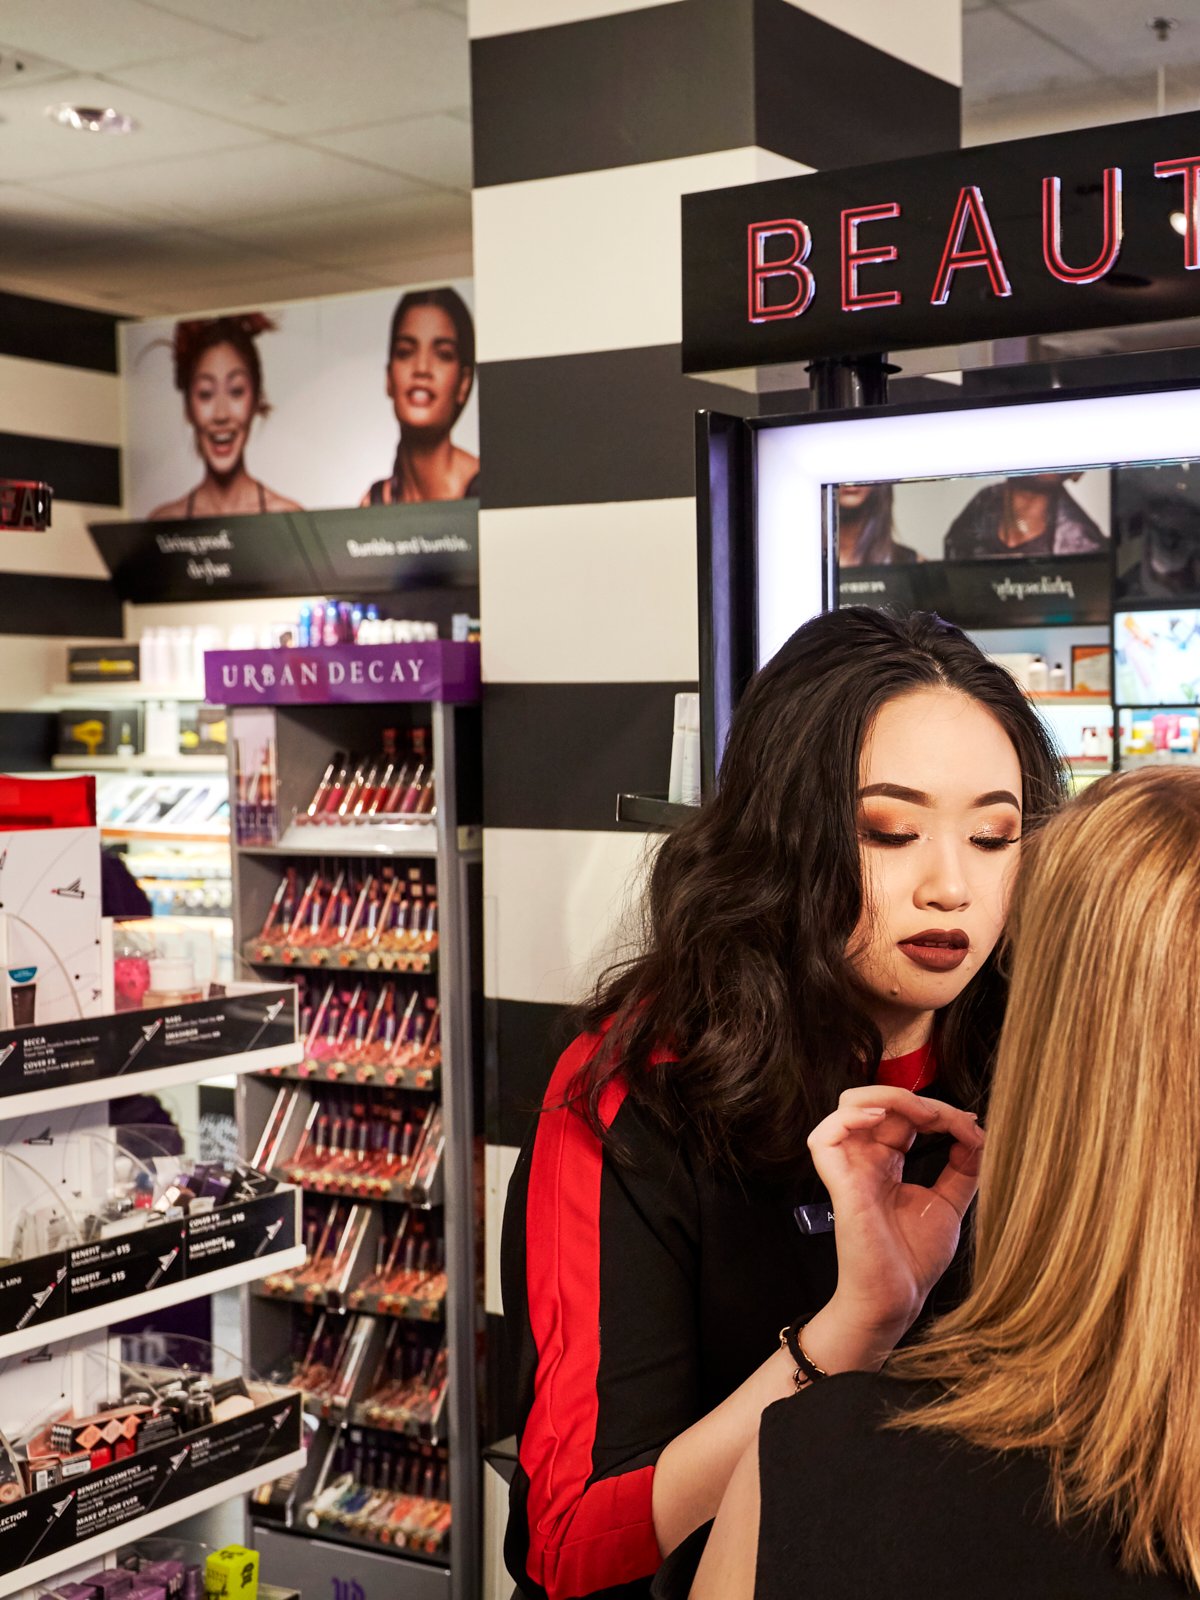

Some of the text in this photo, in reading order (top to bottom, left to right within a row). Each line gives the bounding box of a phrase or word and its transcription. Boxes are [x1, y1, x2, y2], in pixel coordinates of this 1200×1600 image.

[346, 538, 396, 559] Bumble
[396, 535, 420, 556] and
[222, 658, 425, 694] URBAN DECAY
[71, 1245, 100, 1261] BENEFIT
[71, 1271, 100, 1287] BENEFIT
[0, 1509, 28, 1528] ECTION
